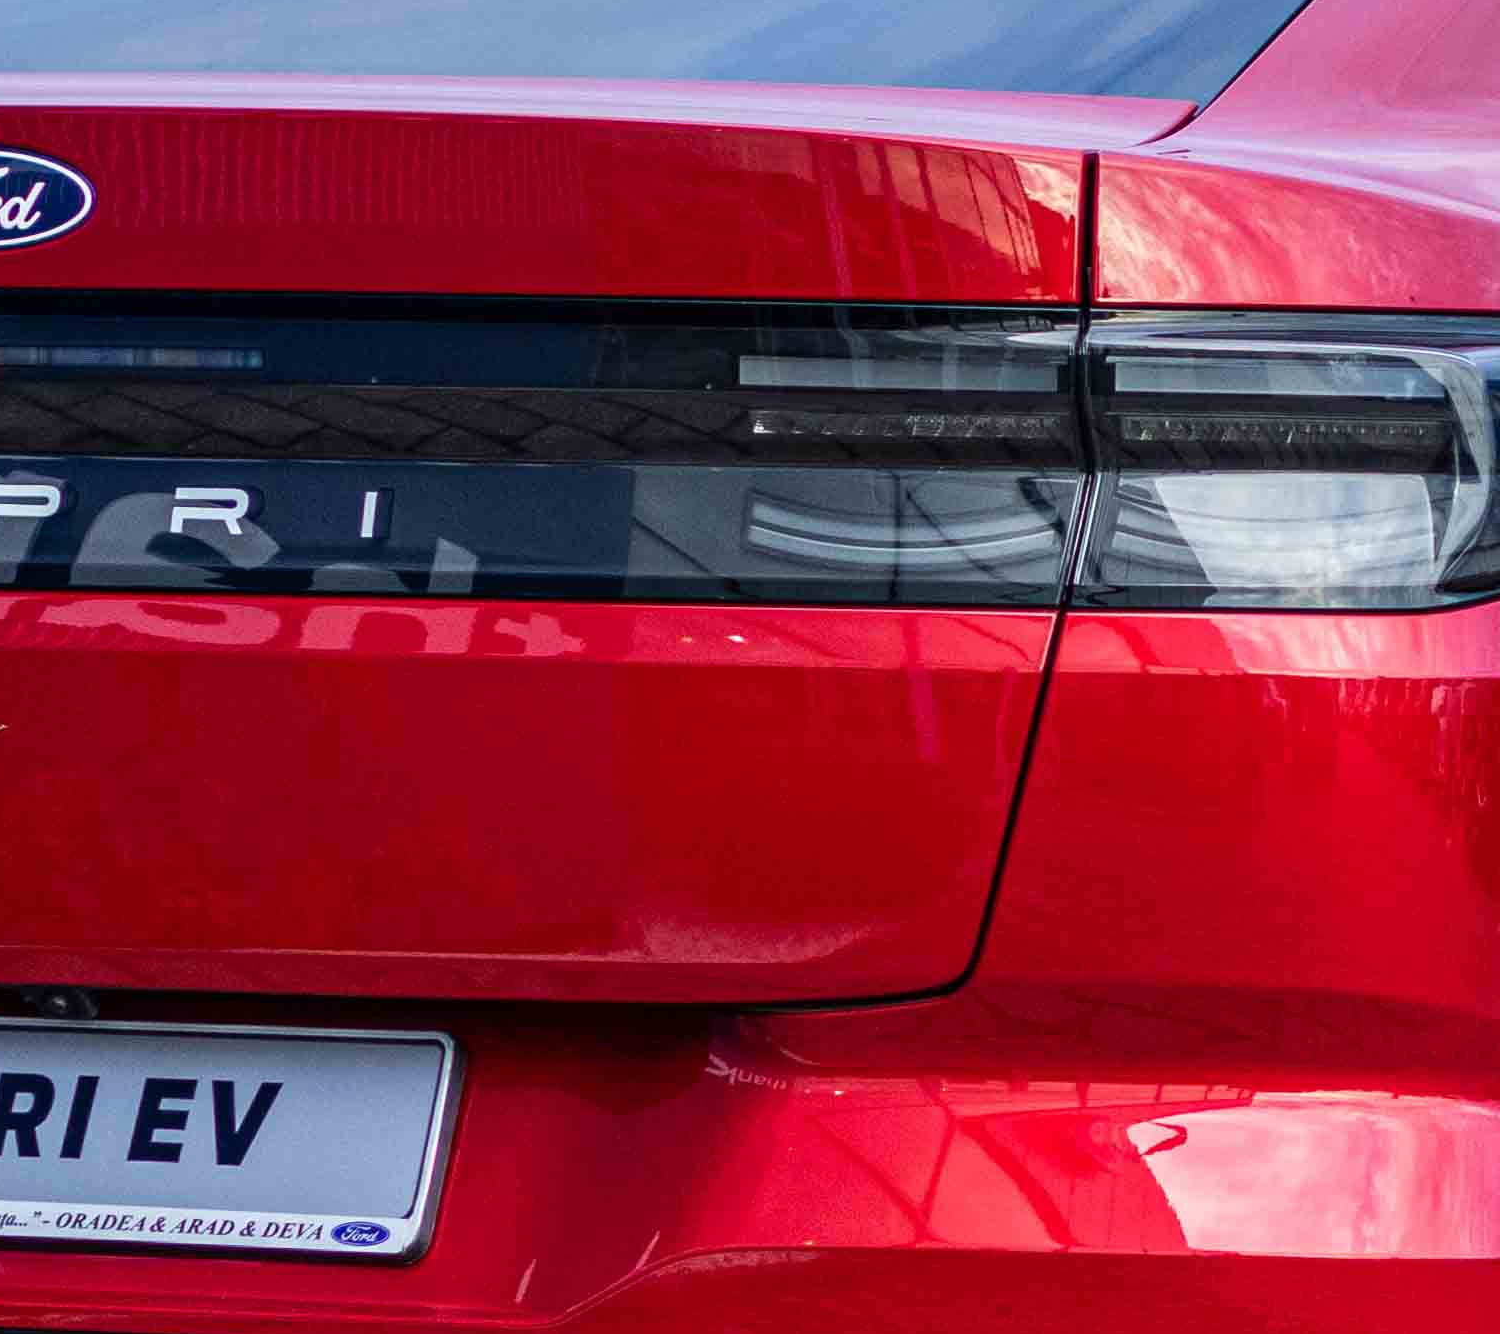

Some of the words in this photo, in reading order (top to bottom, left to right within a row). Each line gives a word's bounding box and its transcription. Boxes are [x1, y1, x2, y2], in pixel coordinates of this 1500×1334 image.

[127, 1077, 284, 1166] EV
[56, 1212, 146, 1232] ORADEA
[150, 1216, 166, 1233] &
[170, 1218, 235, 1236] ARAD
[239, 1220, 256, 1237] &
[262, 1221, 324, 1241] DEVA
[337, 1224, 383, 1244] Ford
